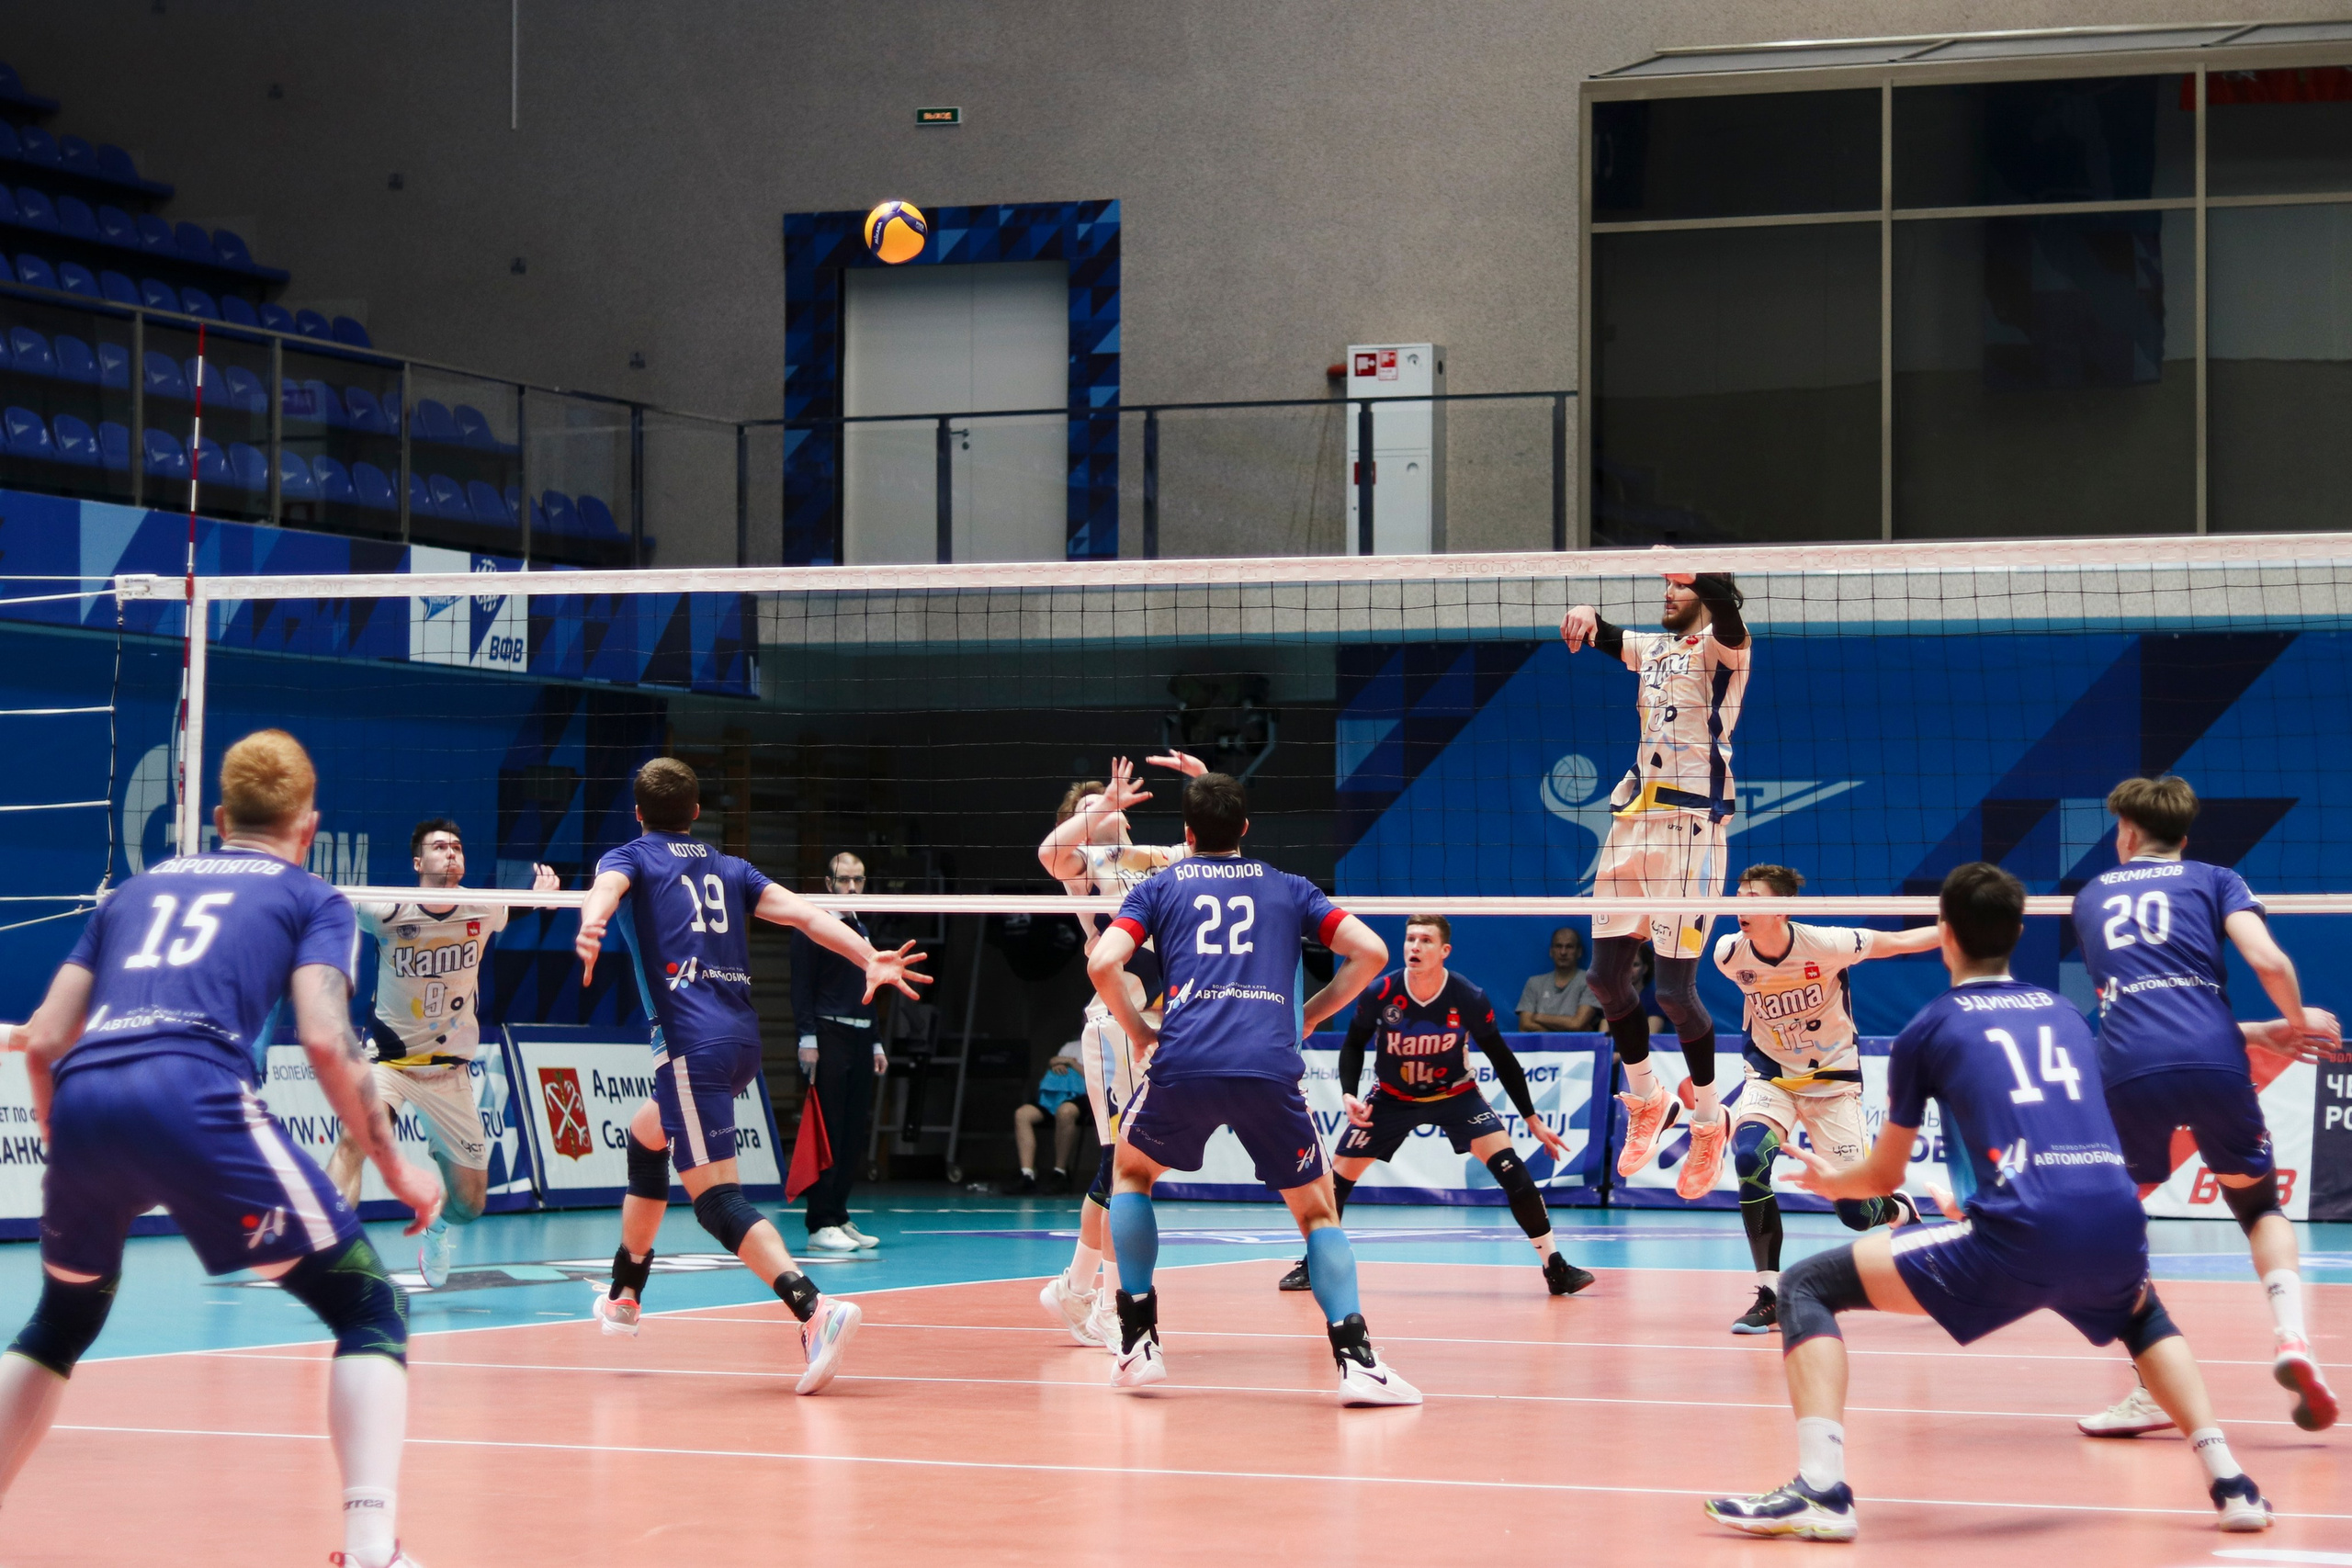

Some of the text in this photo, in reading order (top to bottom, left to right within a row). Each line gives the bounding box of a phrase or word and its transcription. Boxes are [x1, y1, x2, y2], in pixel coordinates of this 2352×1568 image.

[489, 636, 524, 662] ВФВ
[668, 842, 707, 857] КОТОВ
[149, 858, 285, 874] СЫРОПЯТОВ
[1175, 863, 1263, 881] БОГОМОЛОВ
[2100, 865, 2184, 885] ЧЕКМИЗОВ
[681, 874, 729, 933] 19
[123, 892, 234, 969] 15
[1193, 895, 1255, 954] 22
[2102, 891, 2170, 951] 20
[394, 940, 479, 978] Kama
[424, 981, 446, 1018] 9
[1195, 987, 1284, 1005] АВТОМОБИЛИСТ
[1746, 983, 1824, 1021] Kama
[1954, 992, 2054, 1011] УДИНЦЕВ
[1386, 1031, 1458, 1056] Kama
[1400, 1060, 1434, 1086] 14
[1984, 1025, 2082, 1104] 14
[1346, 1128, 1372, 1149] 14
[2188, 1167, 2298, 1207] ВВ
